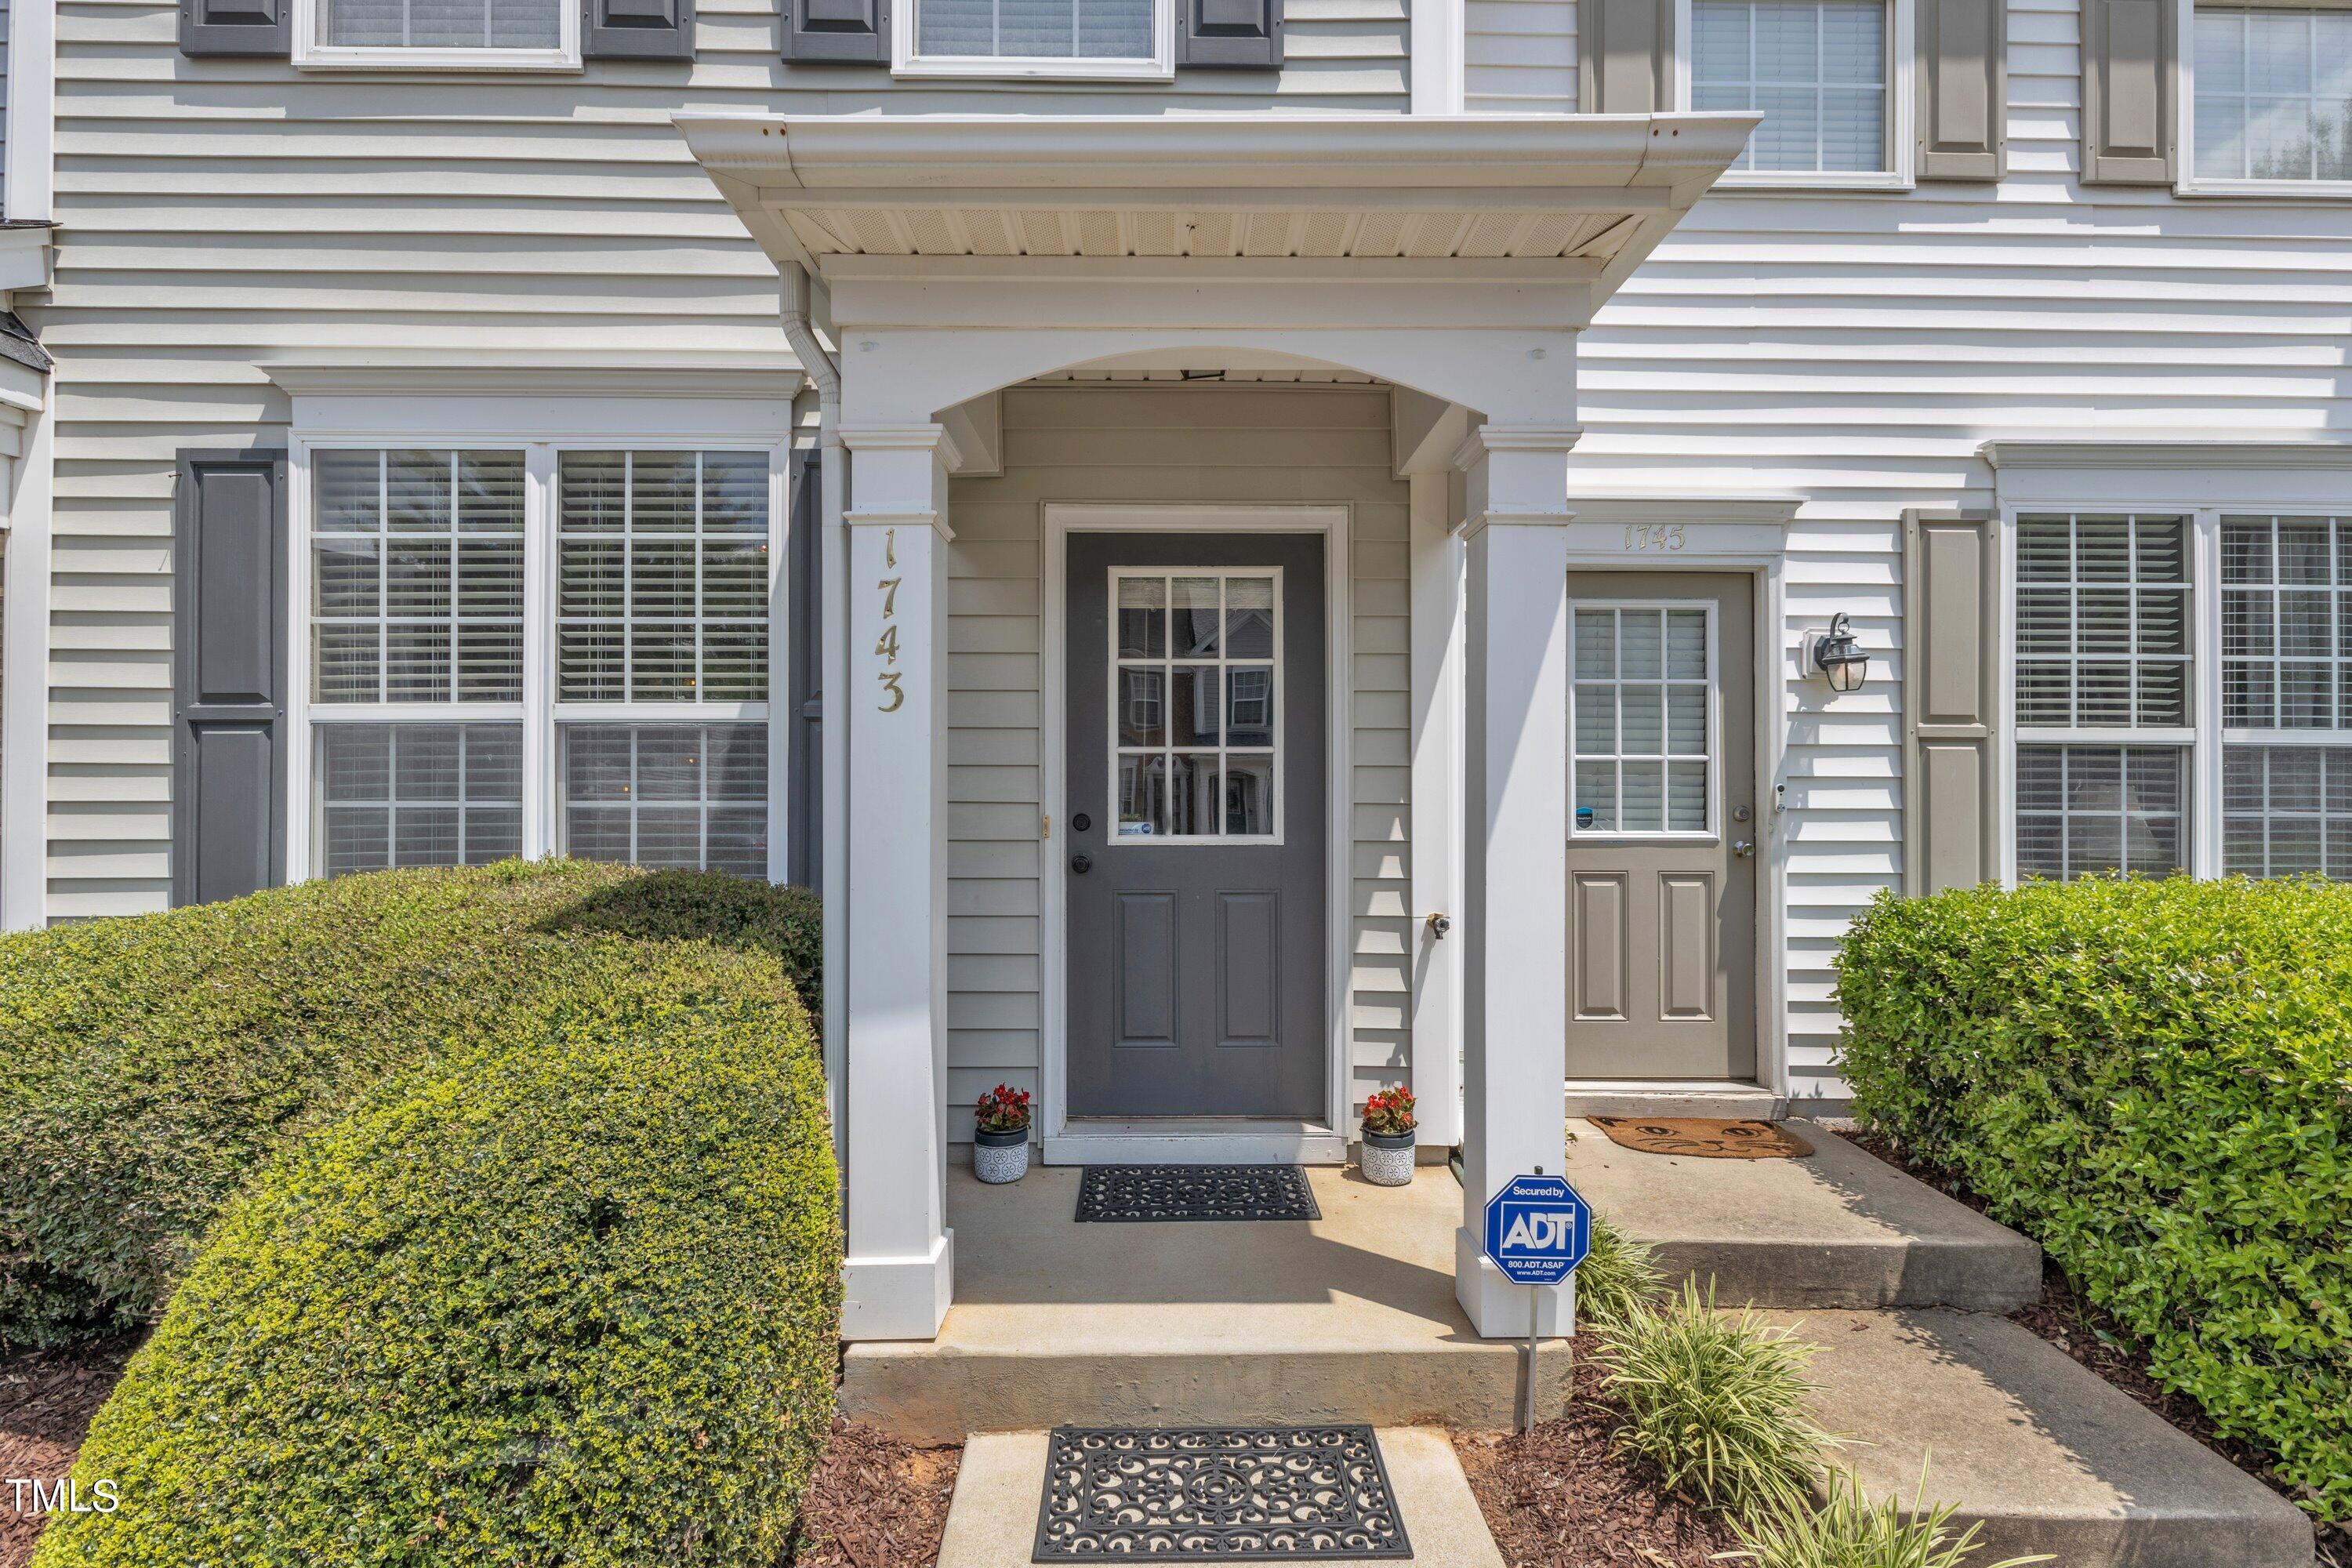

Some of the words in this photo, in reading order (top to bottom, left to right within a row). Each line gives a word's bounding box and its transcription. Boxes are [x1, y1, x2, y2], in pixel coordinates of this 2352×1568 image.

[1624, 524, 1686, 550] 1745
[875, 528, 904, 712] 1743
[1513, 1186, 1552, 1196] Secured
[1553, 1188, 1564, 1197] by
[1502, 1213, 1573, 1250] ADT
[1508, 1261, 1564, 1269] 800.ADT.ASAP
